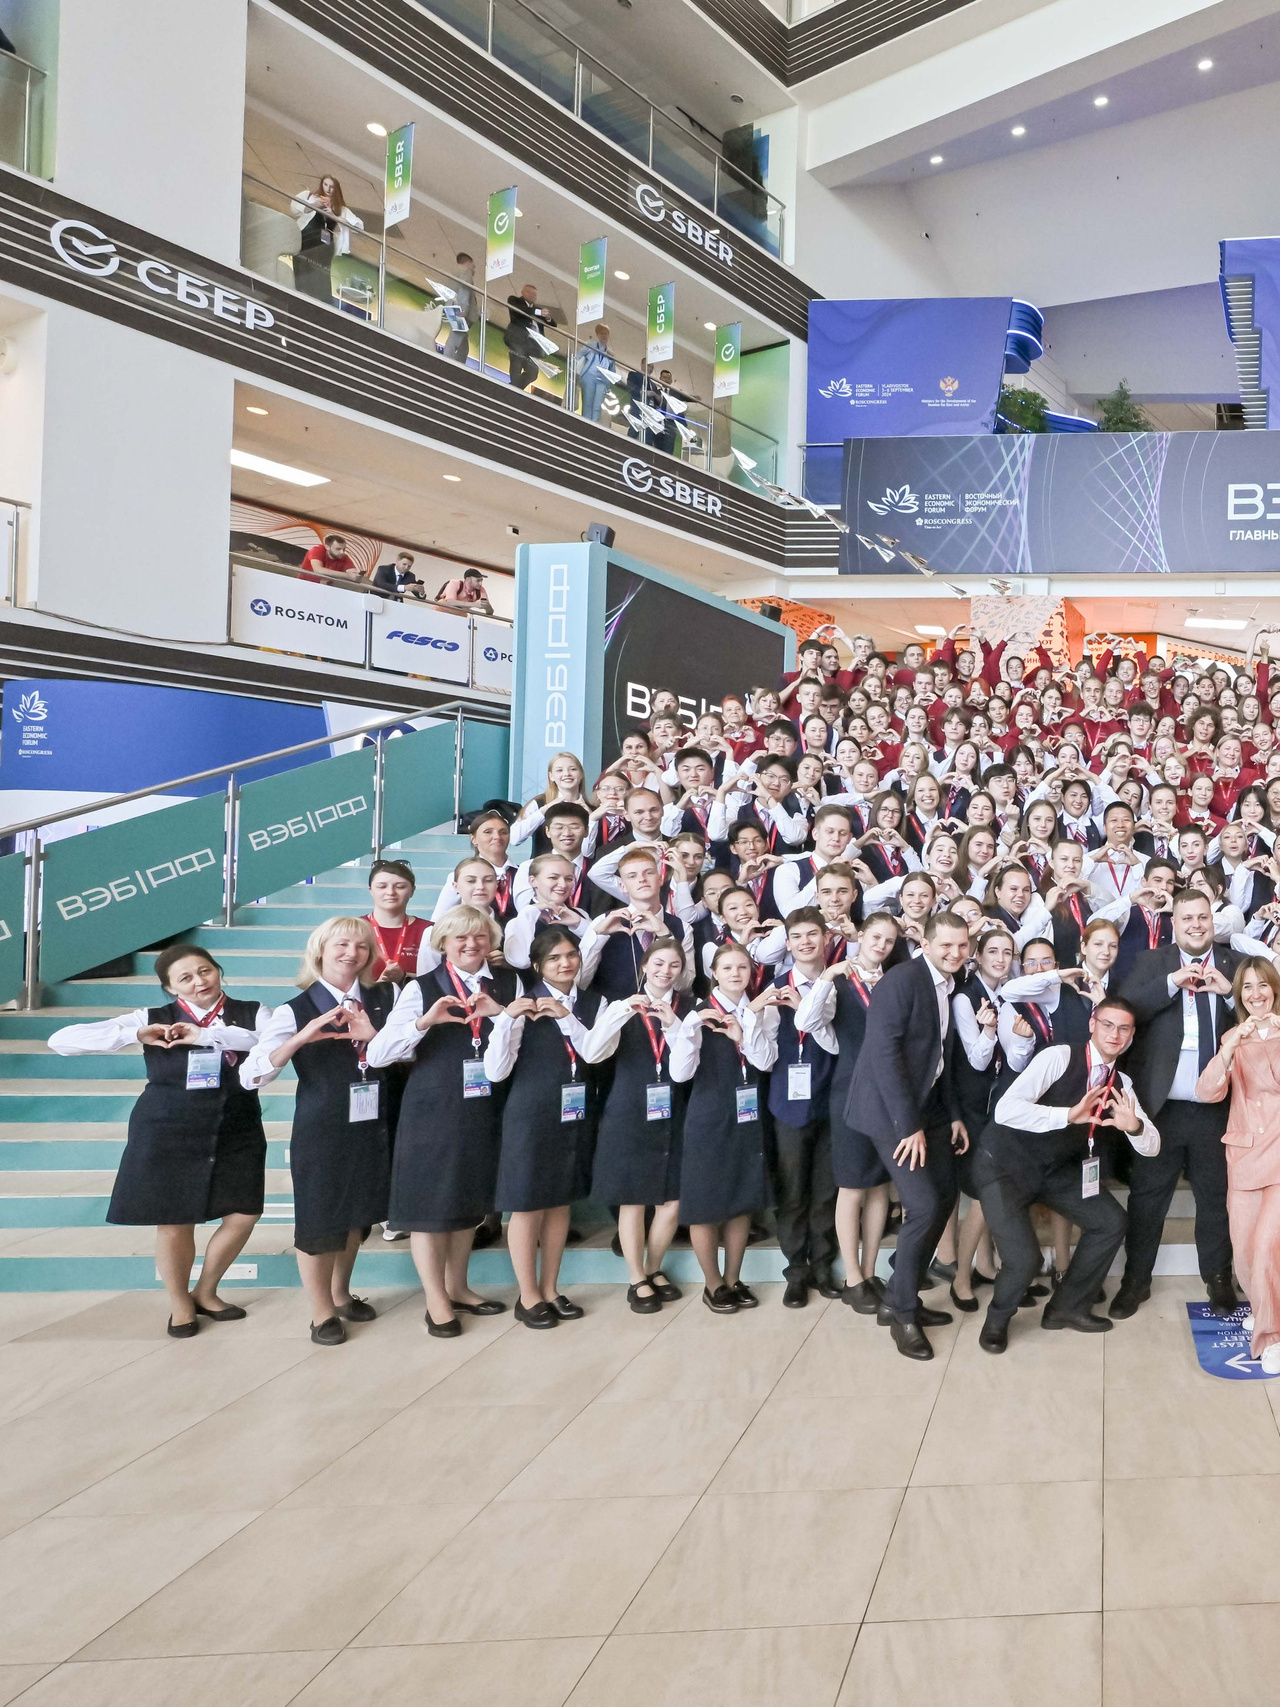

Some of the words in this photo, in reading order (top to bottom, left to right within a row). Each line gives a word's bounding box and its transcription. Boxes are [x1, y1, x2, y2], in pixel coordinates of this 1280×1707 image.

[394, 140, 404, 188] SBER
[672, 211, 733, 267] SBER
[137, 260, 275, 330] СБЕР
[656, 294, 665, 334] СБЕР
[660, 476, 722, 518] SBER
[274, 605, 348, 630] ROSATOM
[386, 630, 460, 652] FESCO
